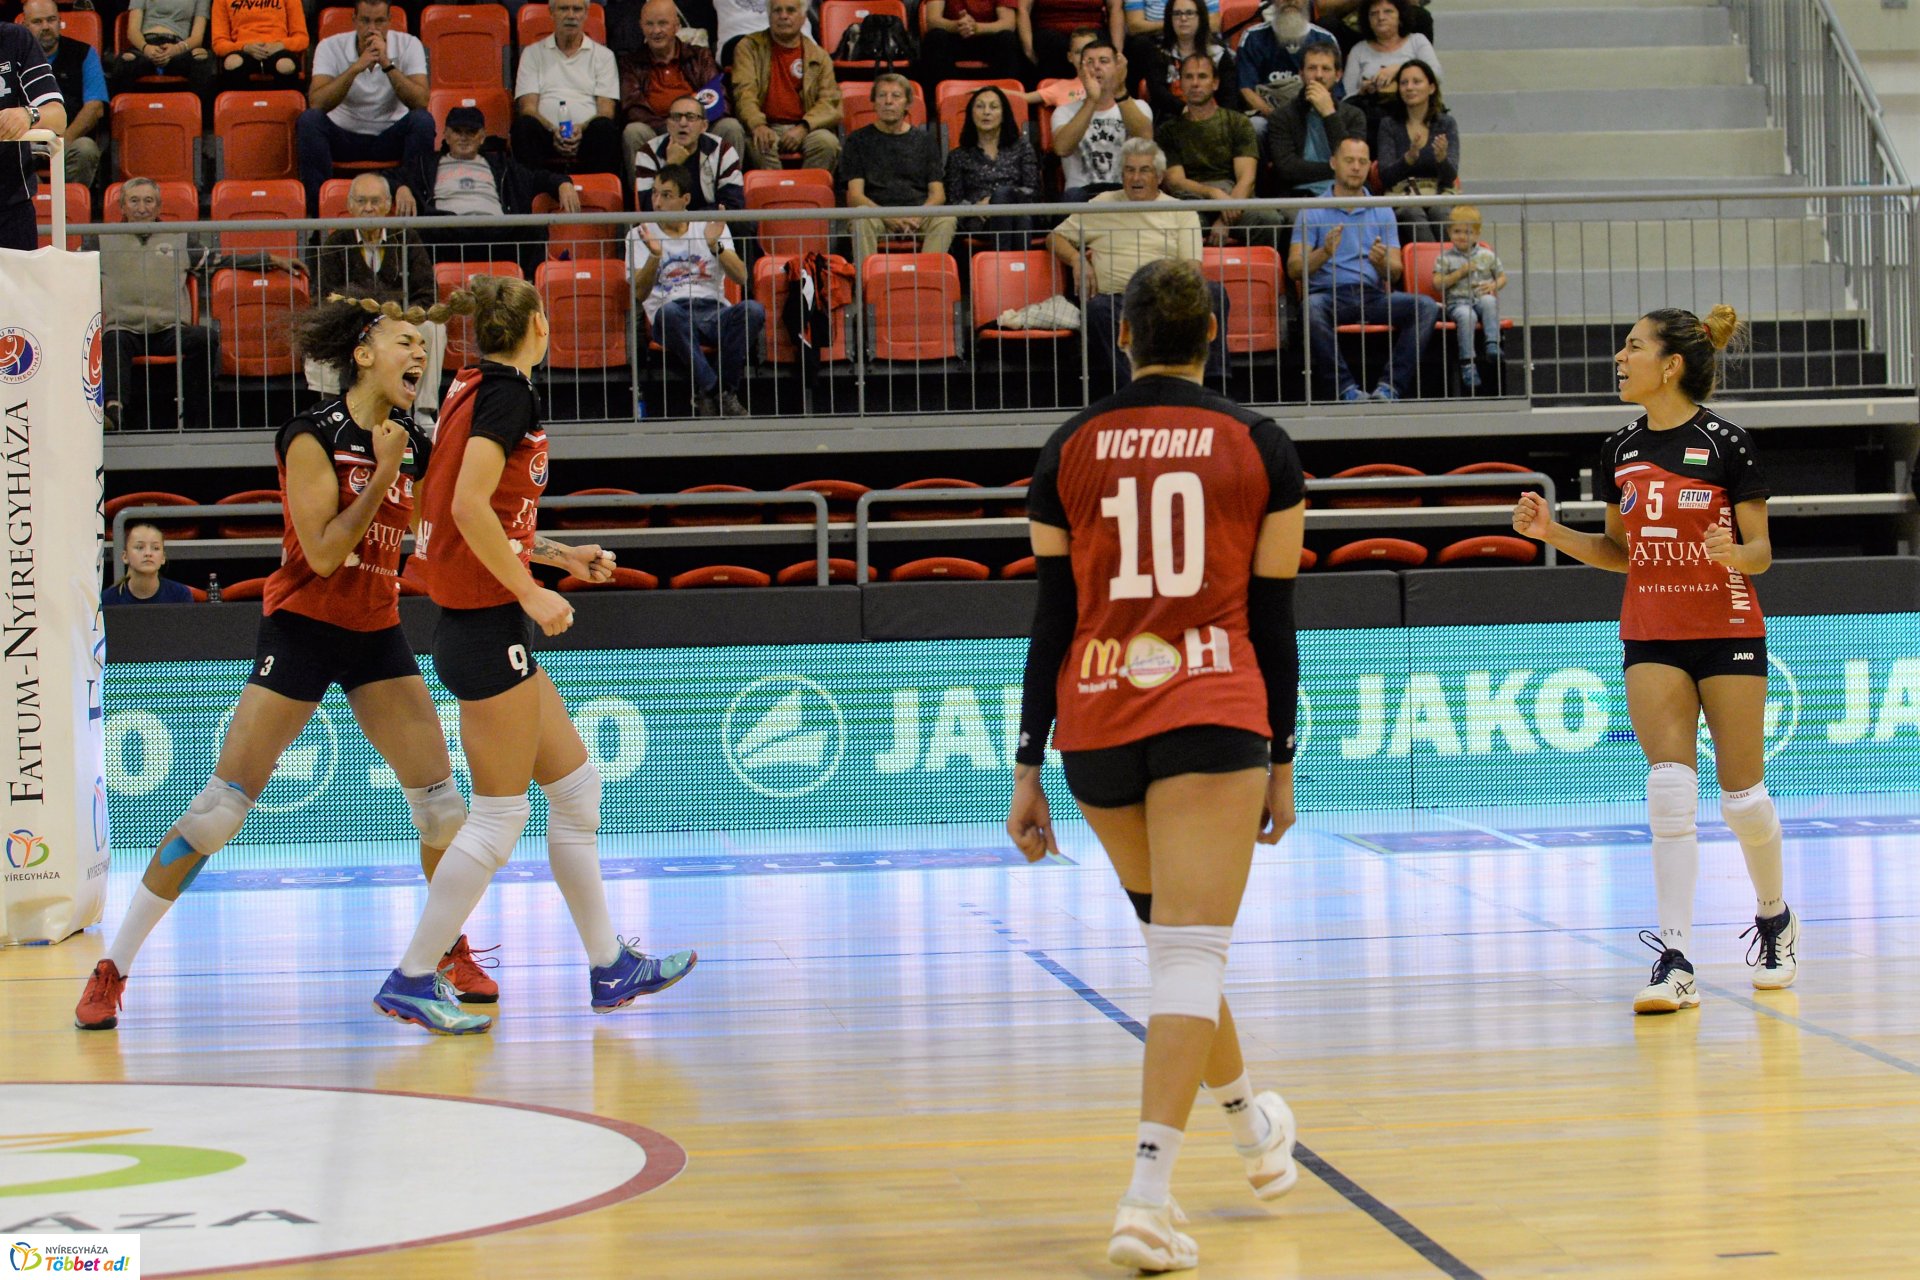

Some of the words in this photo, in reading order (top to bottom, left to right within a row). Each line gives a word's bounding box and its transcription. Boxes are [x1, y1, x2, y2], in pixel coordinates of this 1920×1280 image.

[1096, 427, 1214, 460] VICTORIA
[1622, 449, 1639, 461] JAKO
[1645, 481, 1664, 521] 5
[1680, 491, 1711, 502] FATUM
[1100, 471, 1205, 601] 10
[1638, 583, 1719, 593] NYÍREGYHÁZA
[259, 655, 275, 677] 3
[507, 643, 528, 677] 9
[1733, 651, 1755, 661] JAKO
[1341, 667, 1610, 760] JAKO
